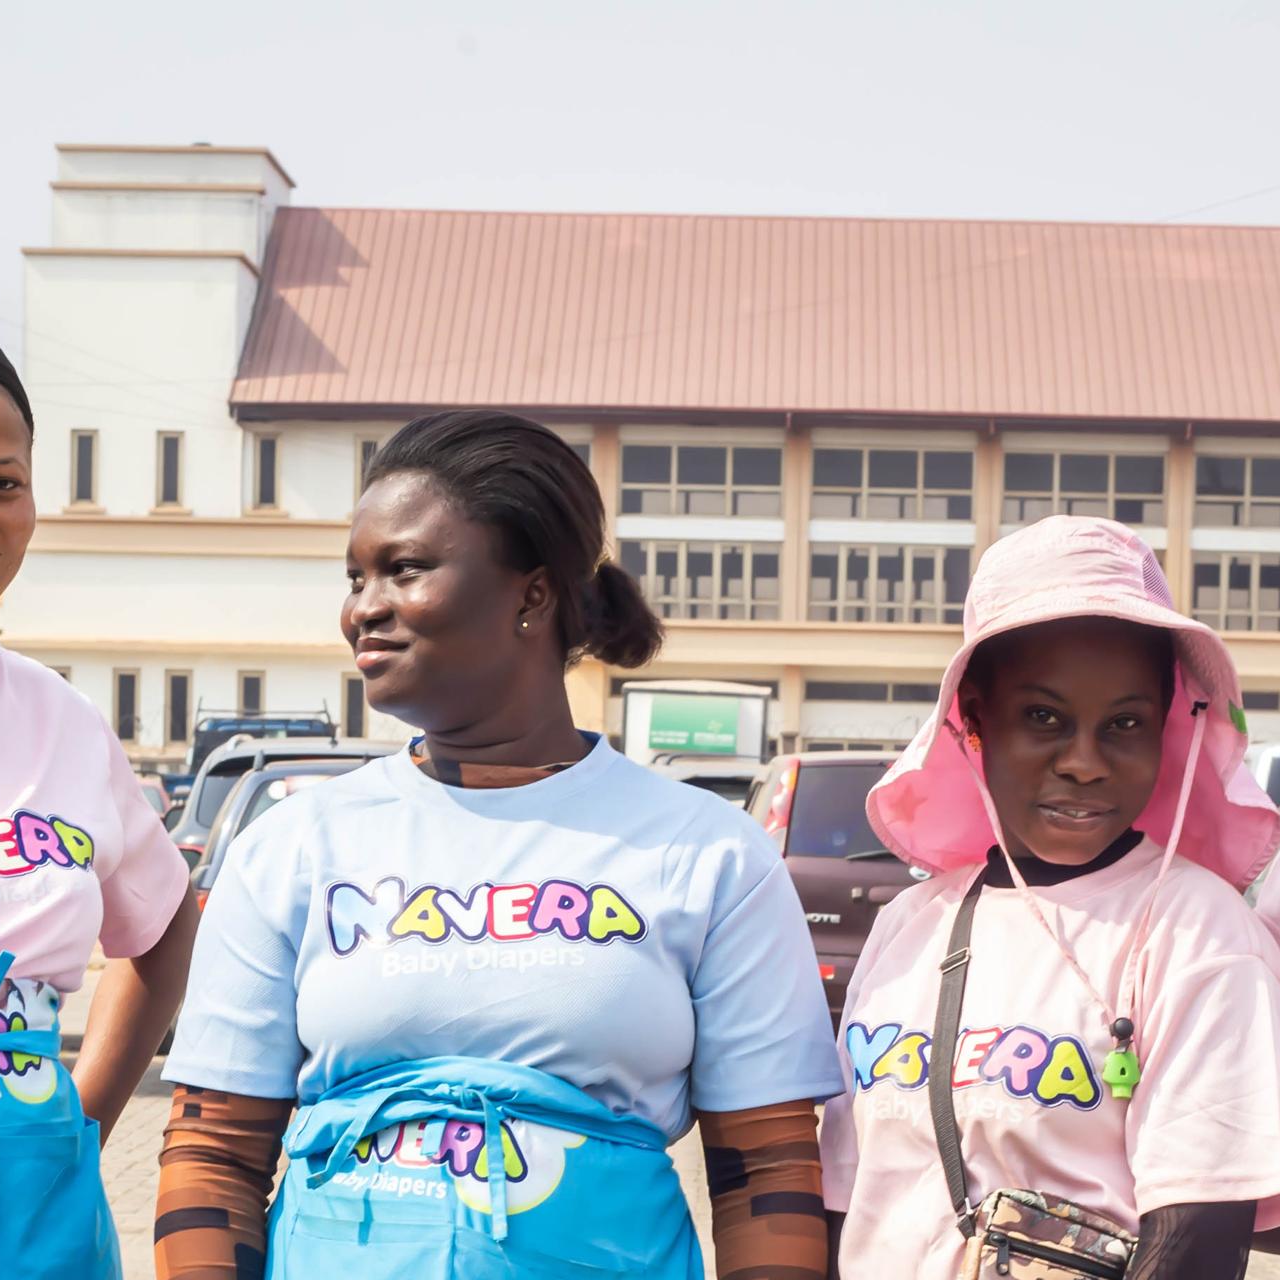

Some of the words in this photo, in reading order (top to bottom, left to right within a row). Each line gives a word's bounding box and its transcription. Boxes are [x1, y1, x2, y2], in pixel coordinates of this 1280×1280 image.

[325, 875, 649, 958] NAVERA
[381, 949, 461, 978] Baby
[466, 945, 586, 974] Diapers
[846, 1020, 1102, 1110] NAERA
[370, 1171, 448, 1199] Diapers
